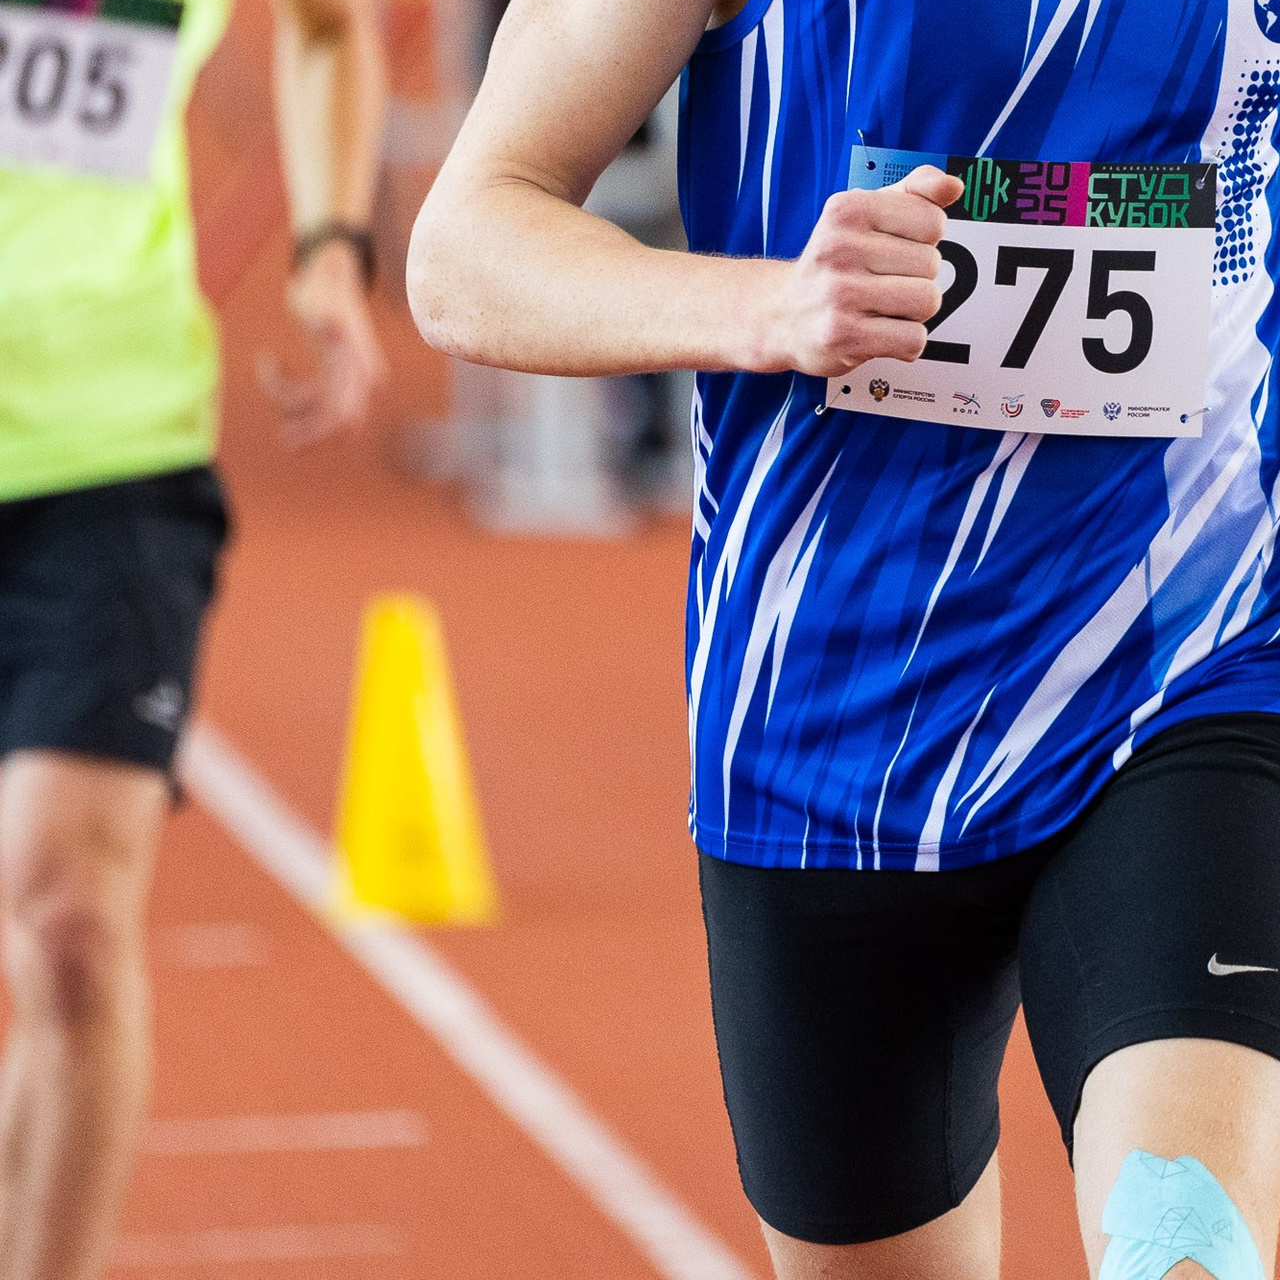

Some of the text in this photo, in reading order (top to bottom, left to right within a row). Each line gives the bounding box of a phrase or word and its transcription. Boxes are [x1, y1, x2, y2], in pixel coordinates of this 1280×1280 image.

[0, 28, 131, 133] 05
[1085, 202, 1190, 228] КУБОК
[1088, 173, 1190, 199] СТУД
[918, 239, 1156, 374] 275
